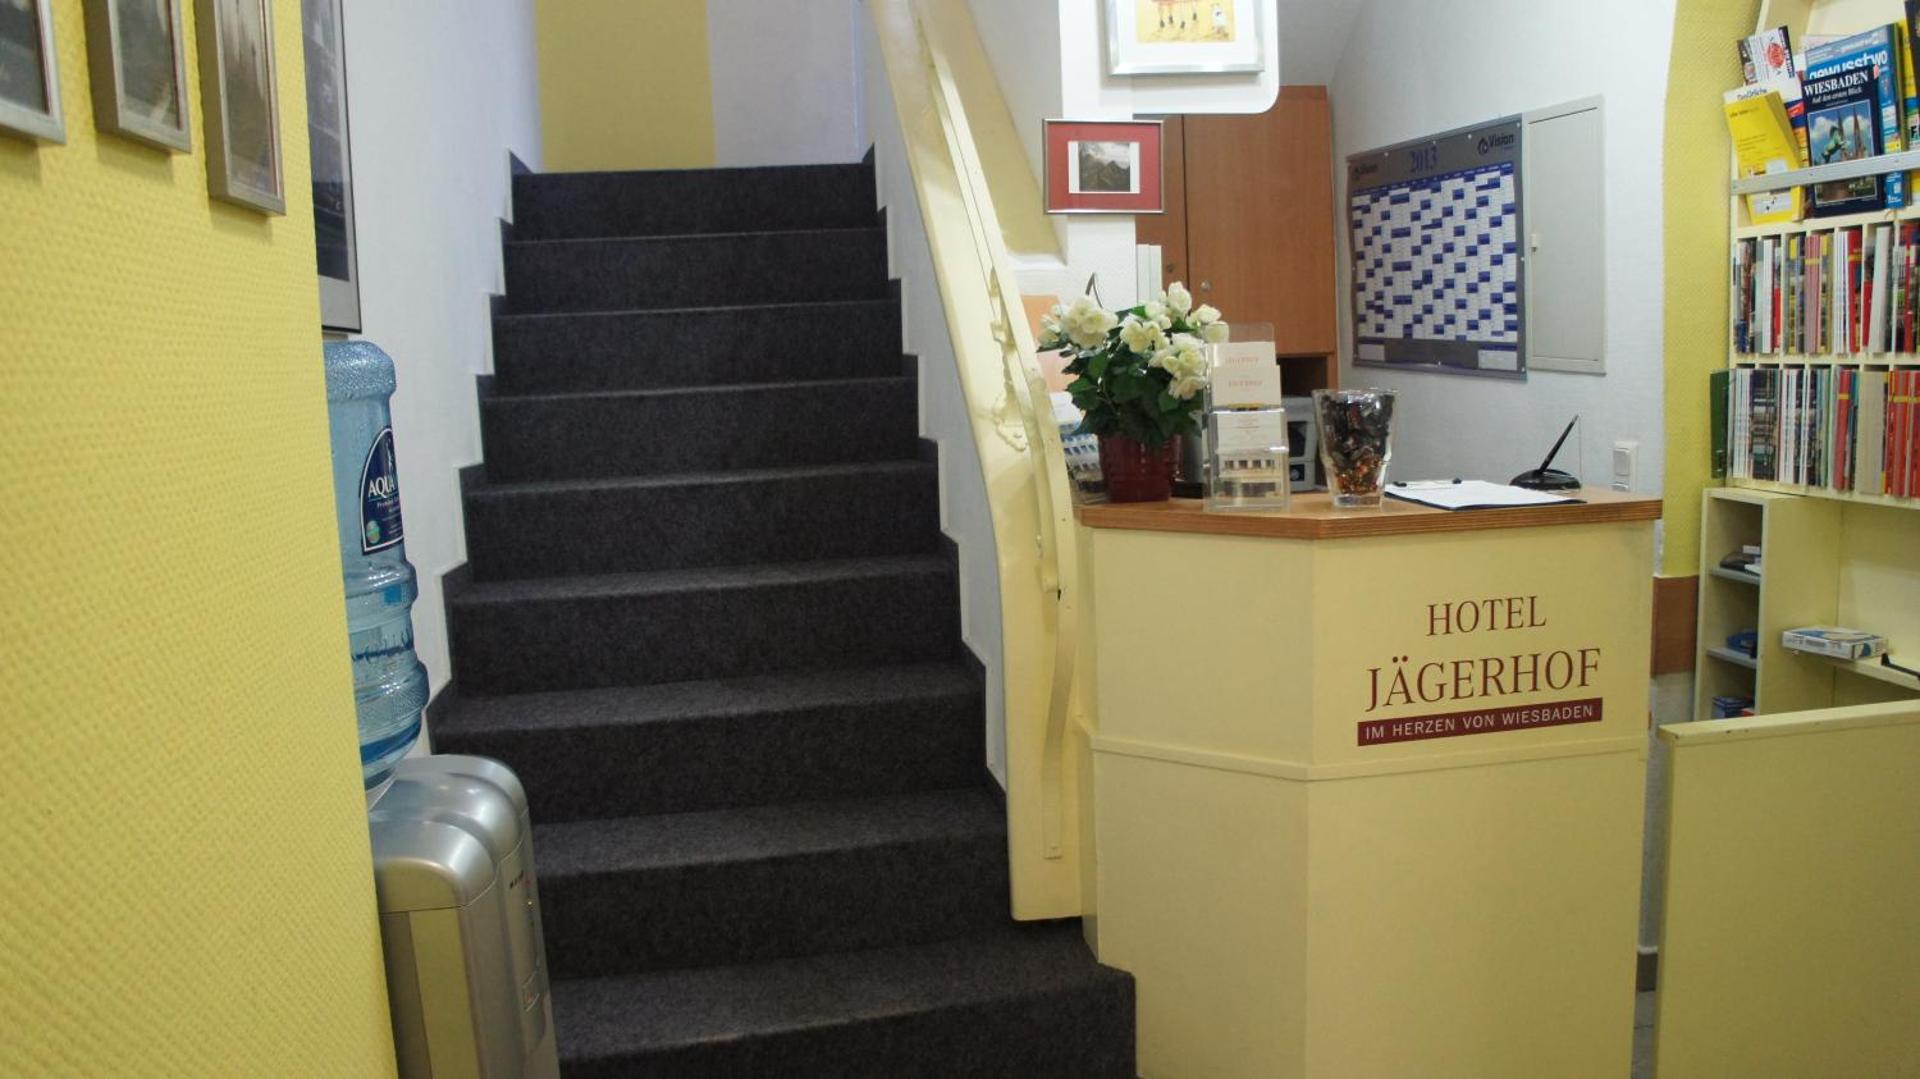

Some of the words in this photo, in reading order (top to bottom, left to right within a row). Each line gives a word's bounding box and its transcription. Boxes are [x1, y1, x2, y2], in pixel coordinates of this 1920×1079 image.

[1804, 71, 1869, 97] WIESBADEN
[1488, 133, 1514, 148] Vision
[1410, 145, 1438, 172] 2013
[1426, 595, 1547, 636] HOTEL
[1365, 648, 1601, 712] JÄGERHOF
[1365, 725, 1384, 740] IM
[1392, 718, 1456, 737] HERZEN
[1462, 714, 1495, 730] VON
[1502, 704, 1593, 725] WIESBADEN
